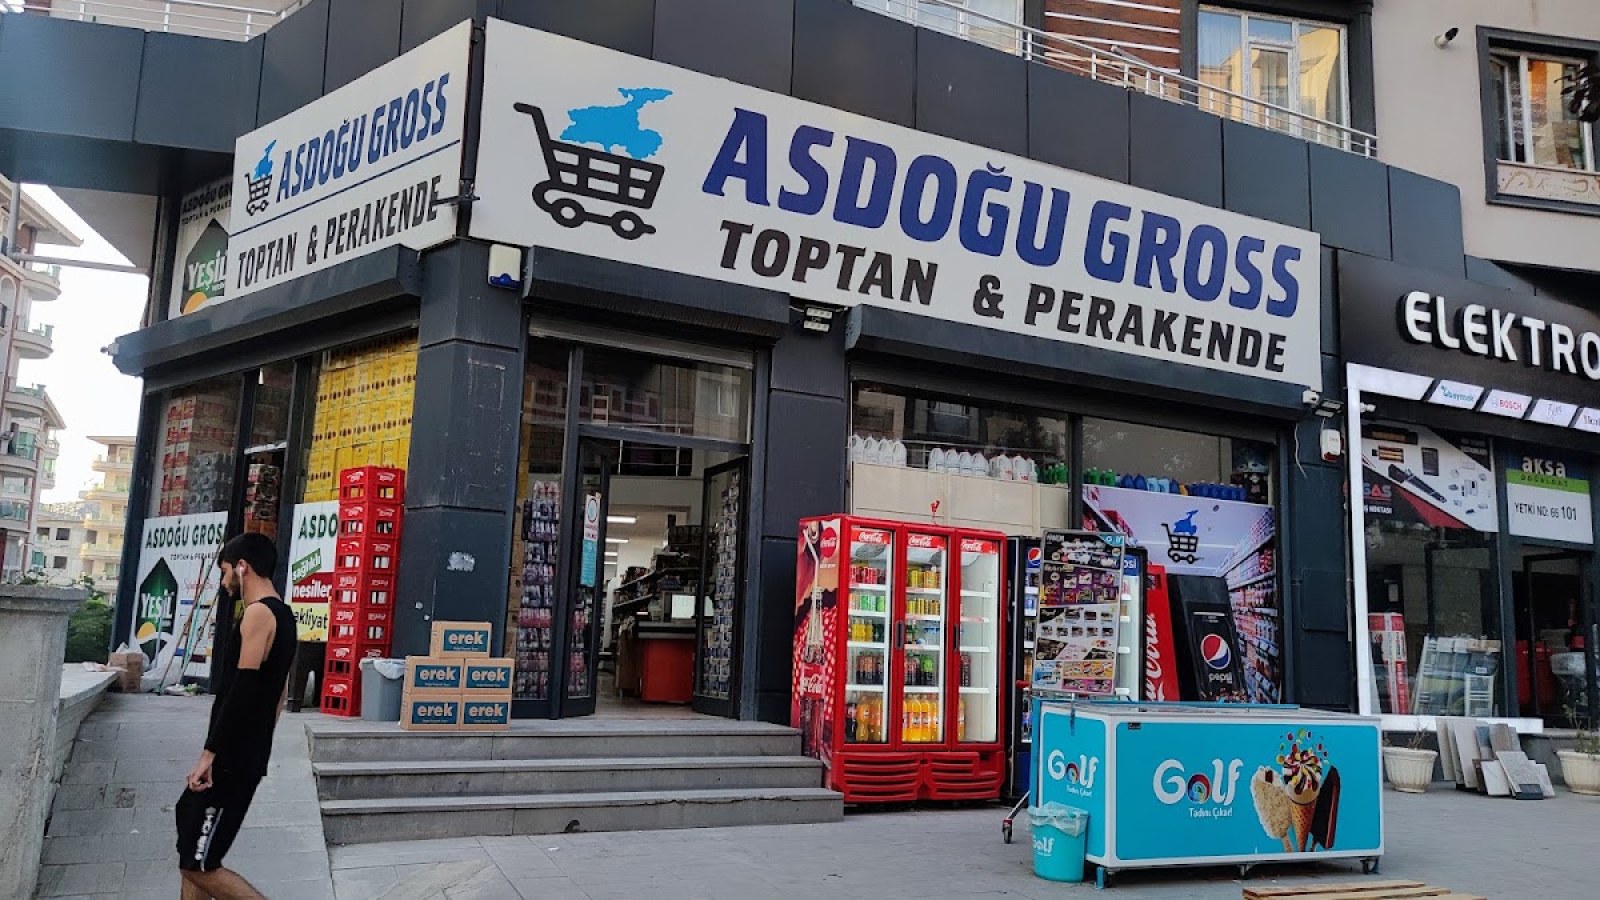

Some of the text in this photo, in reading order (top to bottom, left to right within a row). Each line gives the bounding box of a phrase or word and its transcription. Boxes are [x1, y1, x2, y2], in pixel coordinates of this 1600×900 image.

[275, 72, 450, 204] ASDOĞU GROSS
[702, 106, 1303, 319] ASDOĞU GROSS
[237, 175, 442, 289] TOPTAN & PERAKENDE
[718, 220, 1287, 373] TOPTAN & PERAKENDE
[1404, 291, 1600, 381] ELEKTRO
[1499, 399, 1522, 411] BOSCH
[1522, 456, 1566, 478] aksa
[1561, 506, 1577, 520] 101
[145, 519, 227, 549] ASDOĞU GROS
[299, 513, 338, 539] ASDO
[292, 580, 332, 599] nesiller
[294, 607, 328, 631] akliyat
[448, 631, 485, 645] erek
[419, 666, 457, 681] erek
[471, 668, 507, 681] erek
[416, 703, 454, 717] erek
[469, 703, 505, 717] erek
[1047, 749, 1099, 789] Golf
[1153, 758, 1244, 805] Golf
